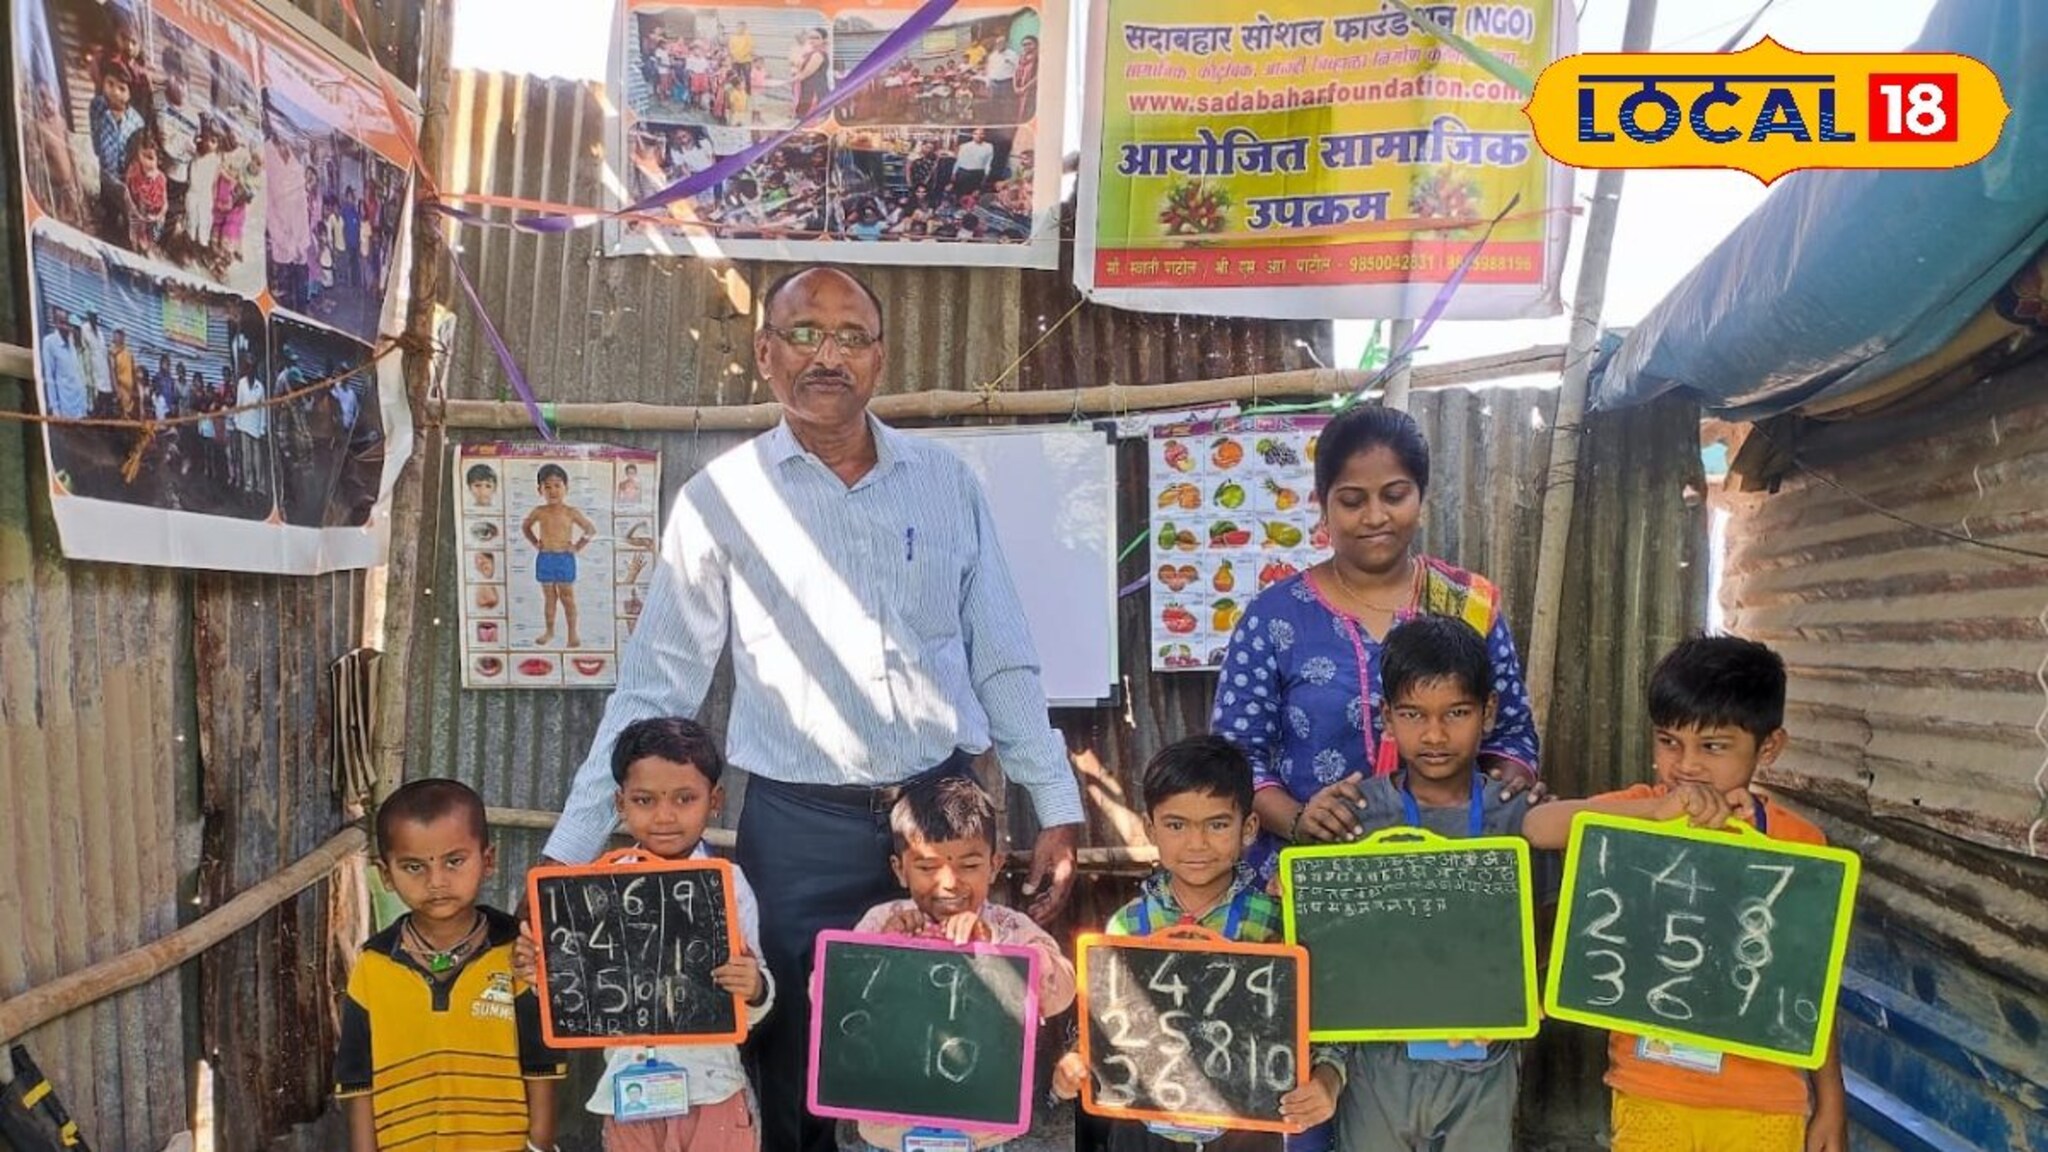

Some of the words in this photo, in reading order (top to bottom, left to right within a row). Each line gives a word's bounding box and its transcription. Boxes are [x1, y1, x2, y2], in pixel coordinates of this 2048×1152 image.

[1125, 25, 1232, 54] सदाबहार
[1241, 14, 1324, 50] सोशल
[1466, 8, 1533, 41] (NGO)
[1129, 75, 1524, 113] www.sadabaharfoundation.com
[1118, 128, 1308, 176] आयोजित
[1321, 118, 1530, 168] सामाजिक
[1248, 192, 1390, 228] उपक्रम
[623, 876, 647, 915] 6
[672, 880, 695, 922] 9
[1637, 848, 1715, 904] 4
[1747, 864, 1794, 907] 7
[588, 919, 620, 960] 4
[627, 922, 658, 961] 7
[1585, 887, 1627, 945] 2
[1656, 912, 1706, 971] 5
[553, 969, 585, 1014] 3
[595, 965, 629, 1014] 5
[929, 962, 960, 1021] 9
[1148, 951, 1189, 1008] 4
[1205, 960, 1237, 1016] 7
[1585, 948, 1626, 1006] 3
[1646, 975, 1694, 1021] 6
[1731, 963, 1760, 1017] 9
[924, 1023, 979, 1083] 10
[1100, 1008, 1150, 1048] 2
[1202, 1019, 1234, 1080] 8
[1249, 1033, 1295, 1092] 10
[1096, 1054, 1139, 1107] 3
[1151, 1055, 1188, 1110] 6
